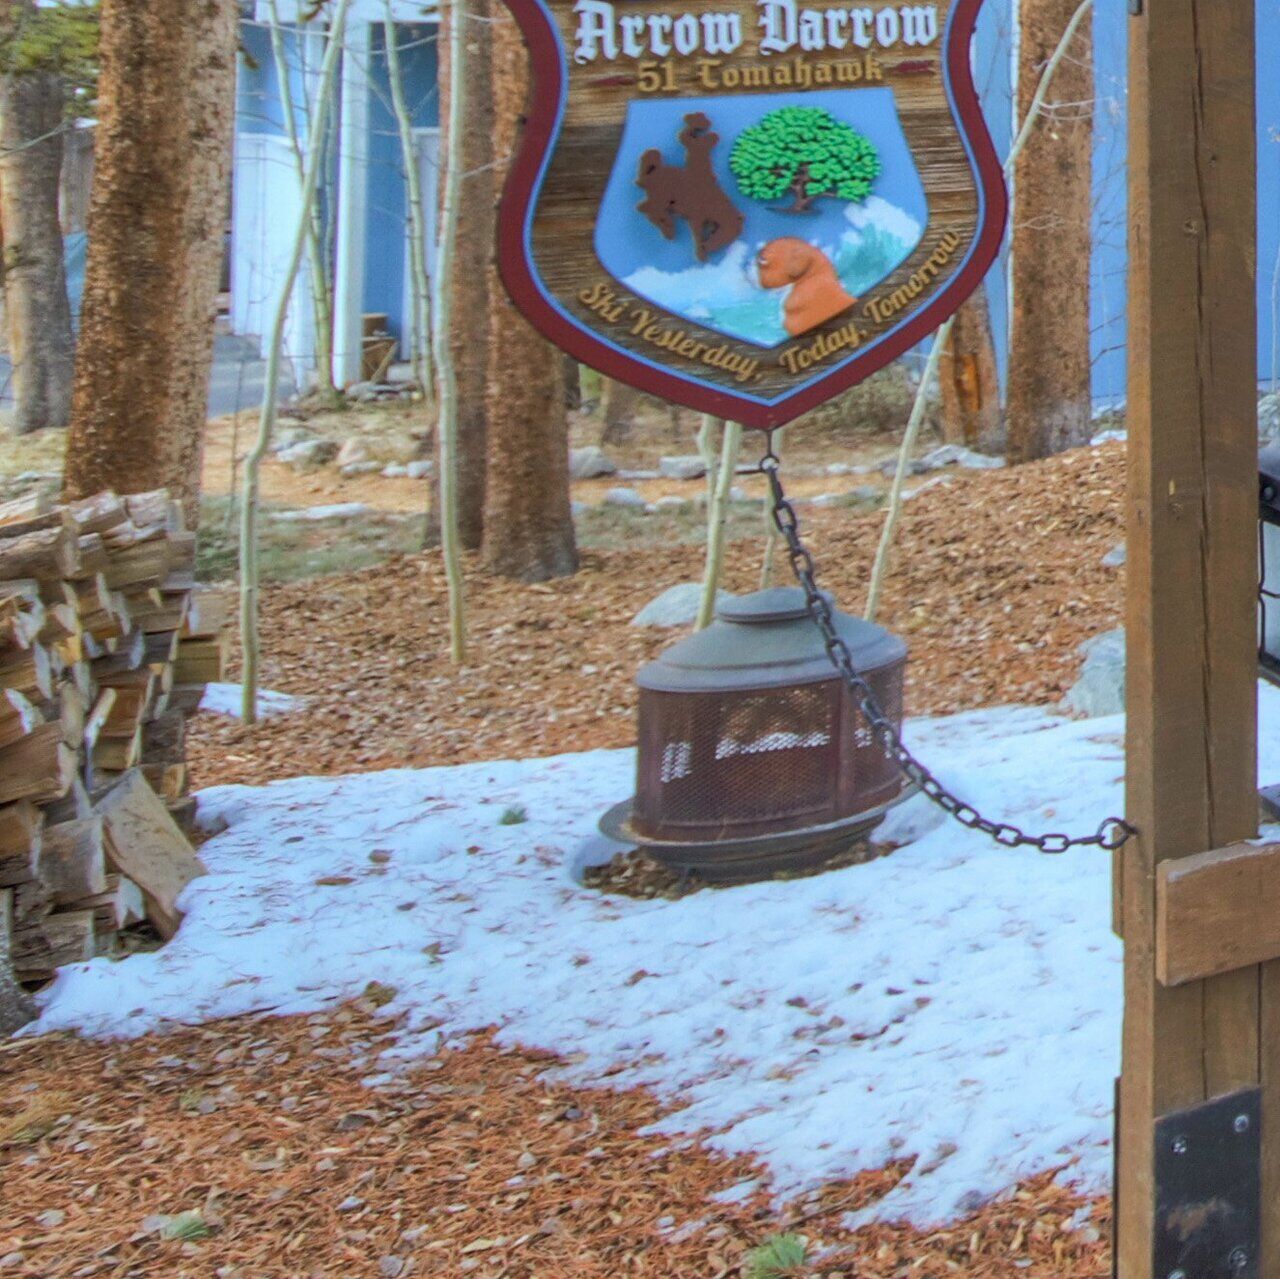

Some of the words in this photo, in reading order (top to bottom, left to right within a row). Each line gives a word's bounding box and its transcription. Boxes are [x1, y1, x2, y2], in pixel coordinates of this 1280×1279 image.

[637, 61, 679, 92] 51
[699, 54, 883, 89] Tomahawk
[580, 283, 622, 323] Ski
[631, 312, 761, 382] Yesterday,
[779, 322, 867, 374] Today,
[862, 229, 960, 323] Tomorrow
